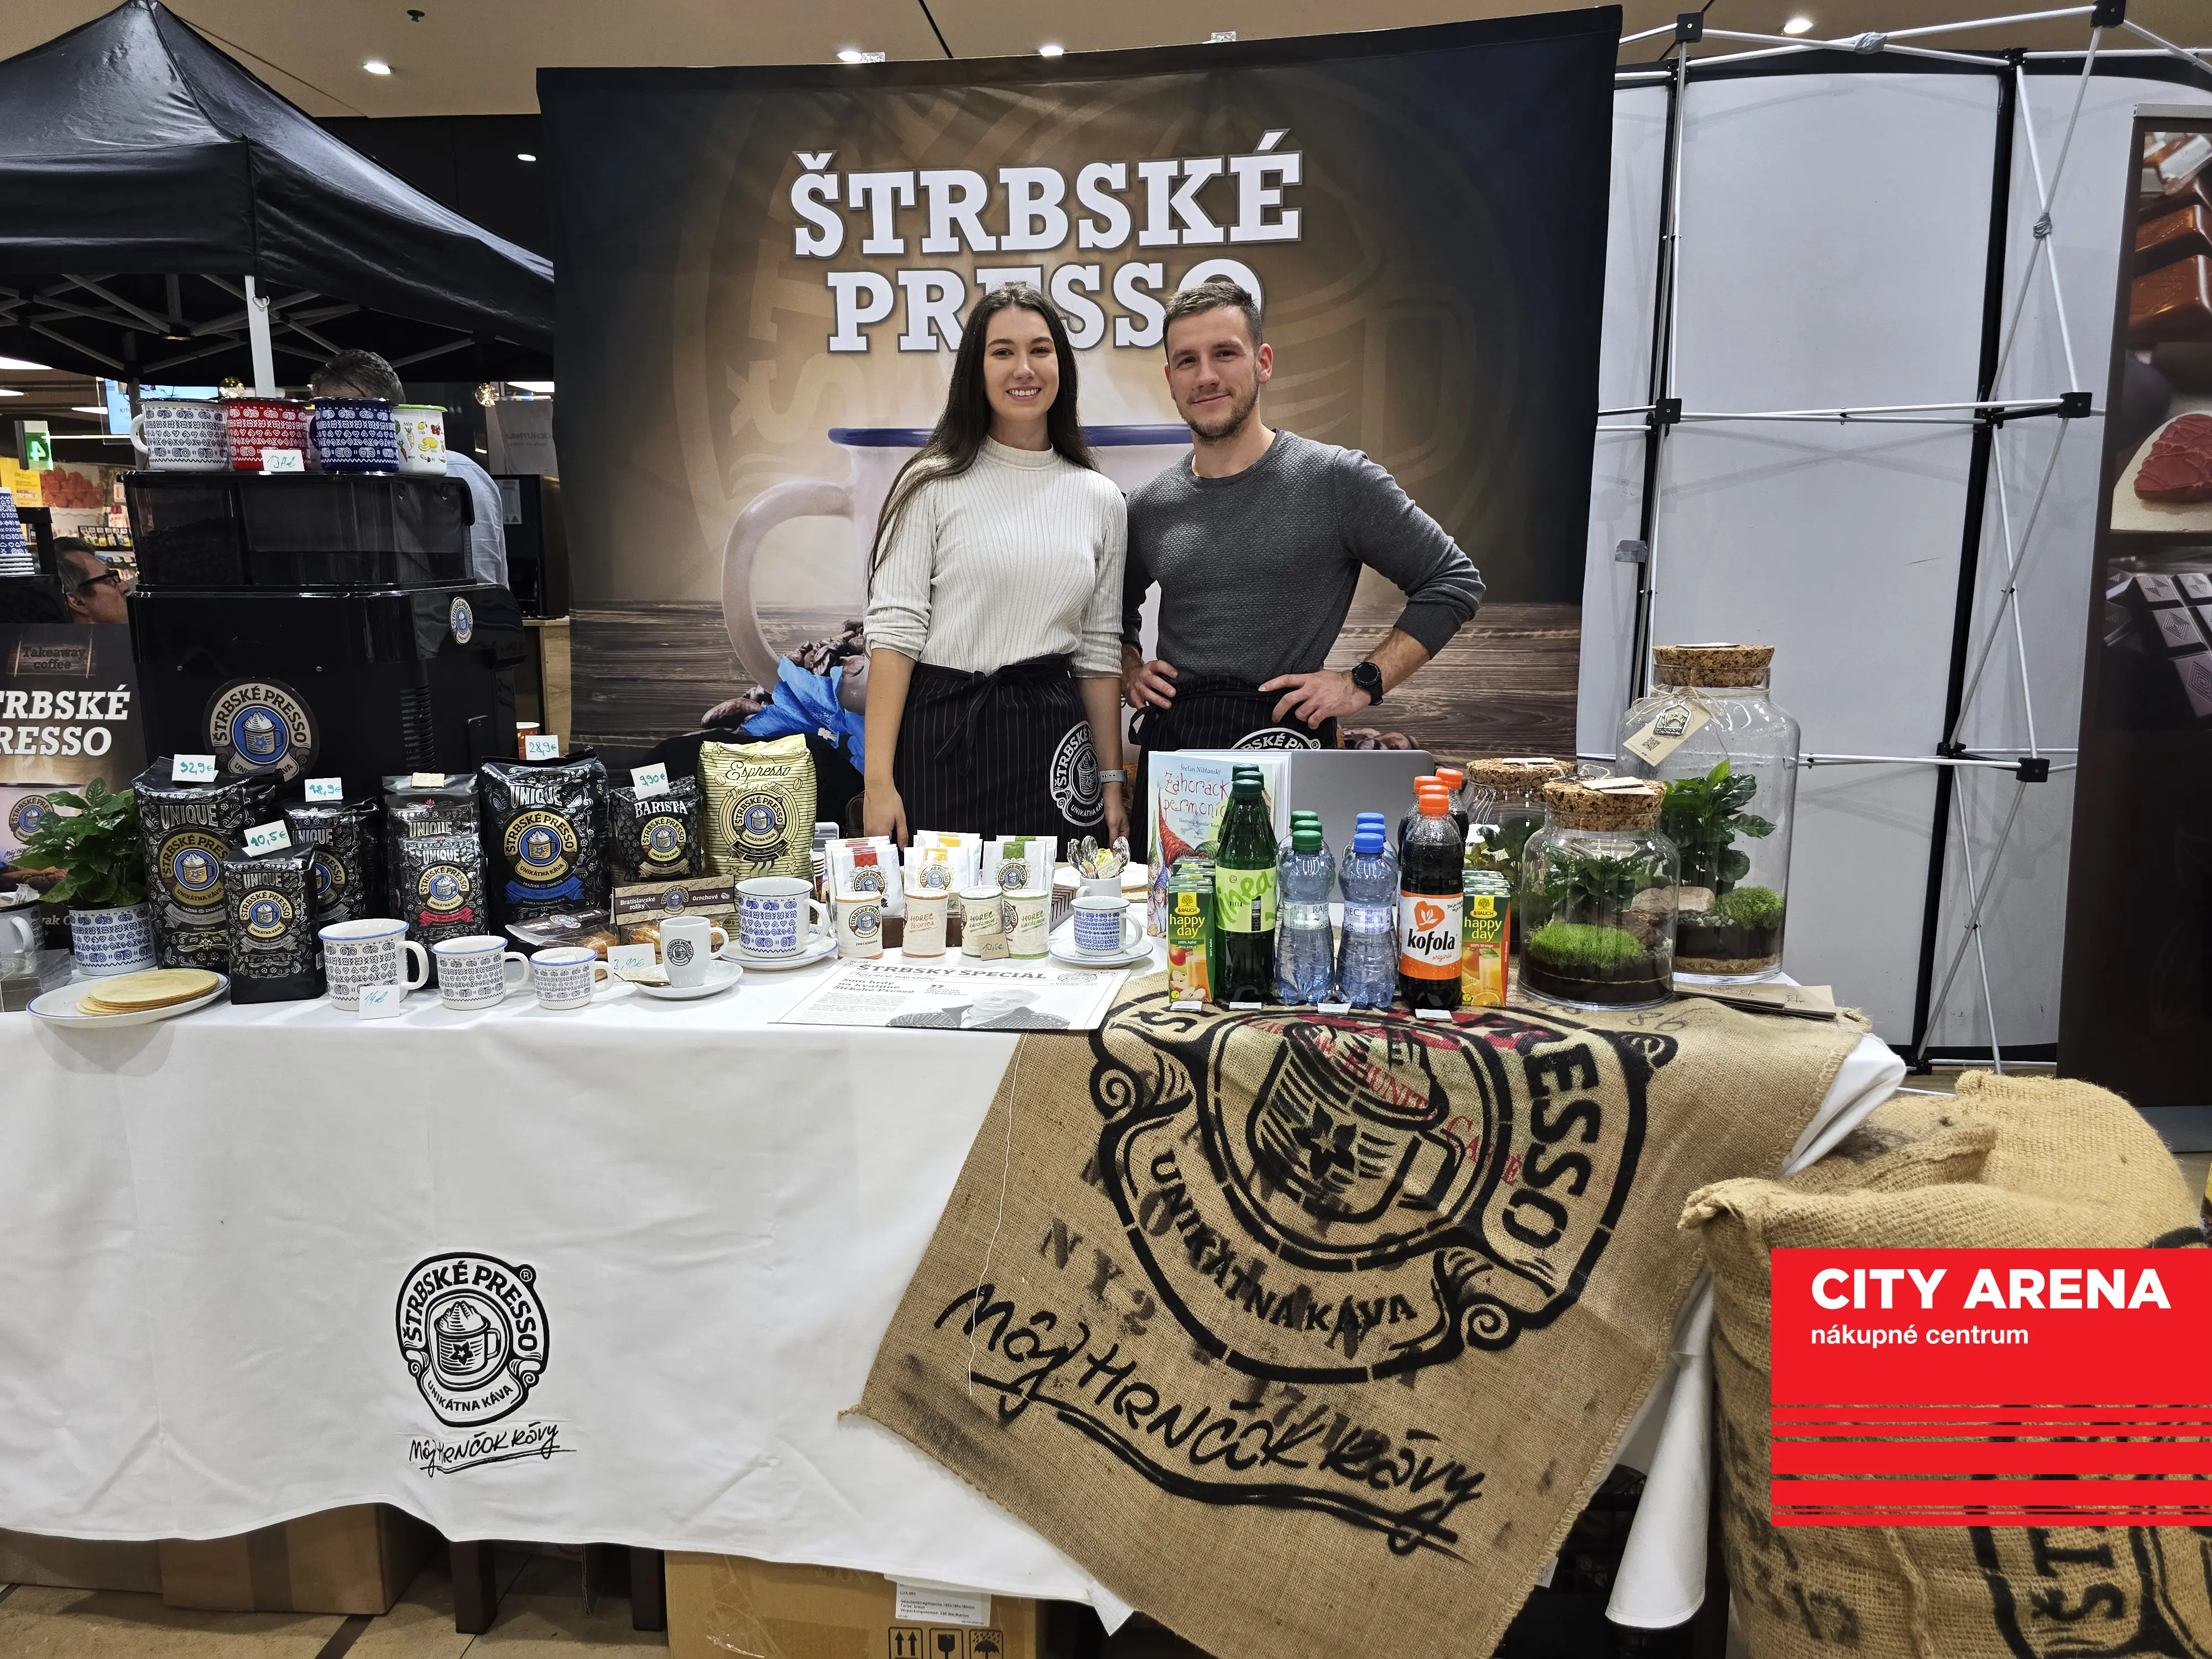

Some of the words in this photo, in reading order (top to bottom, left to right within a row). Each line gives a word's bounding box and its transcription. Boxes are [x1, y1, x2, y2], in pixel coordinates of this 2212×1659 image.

[791, 129, 1302, 257] ŠTRBSKÉ
[827, 258, 1264, 352] PRSS
[23, 646, 87, 661] Takeaway
[33, 659, 71, 669] coffee
[0, 684, 131, 720] RBSKÉ
[212, 685, 262, 742] ŠTRBSKÉ
[263, 689, 307, 743] PRESSO
[0, 726, 112, 756] RESSO
[1240, 733, 1286, 749] BSKÉ
[1055, 726, 1088, 787] ŠTRBSKÉ
[726, 761, 791, 782] Espresso
[1180, 764, 1196, 772] Štefan
[1196, 766, 1222, 776] Nižňanský
[1164, 770, 1230, 801] Záhoráck
[36, 798, 52, 813] PRES
[509, 786, 562, 808] UNIQUE
[1071, 804, 1095, 817] UNIKÁTNA
[1095, 799, 1104, 813] KÁV
[160, 804, 218, 830] UNIQUE
[634, 801, 688, 818] BARISTA
[735, 796, 761, 824] ŠTRBSKÉ
[763, 797, 784, 823] PRESSO
[1163, 799, 1227, 822] permoníc
[409, 821, 453, 838] UNIQUE
[505, 813, 541, 852] ŠTRBSKÉ
[542, 815, 575, 849] PRESSO
[643, 818, 665, 843] ŠTRBSKÉ
[665, 819, 685, 841] PRESSO
[163, 834, 196, 875] ŠTRBSKÉ
[198, 837, 228, 860] PRES
[423, 849, 460, 864] UNIQUE
[317, 854, 342, 882] PRESSO
[520, 865, 549, 877] UNIKÁTNA
[549, 864, 564, 875] KÁVA
[243, 873, 282, 889] UNIQUE
[420, 866, 445, 893] ŠTRBSKÉ
[446, 868, 467, 889] PRESSO
[177, 888, 206, 901] UNIKÁTNA
[241, 891, 268, 918] ŠTRBSKÉ
[268, 893, 290, 916] PRESSO
[620, 896, 656, 906] Bratislavské
[1217, 870, 1272, 929] inea
[1312, 903, 1328, 914] RAJE
[1344, 906, 1360, 916] AJEC
[1170, 914, 1206, 929] happy
[1177, 926, 1199, 939] day
[1464, 916, 1503, 931] happy
[1407, 928, 1455, 956] kofola
[1472, 930, 1495, 942] day
[857, 964, 957, 975] ŠTRBSKÝ
[958, 969, 1047, 979] ŠPECIÁL
[1152, 1149, 1295, 1327] UNIKÁTNA
[1307, 1294, 1417, 1333] KÁVA
[403, 1260, 468, 1342] ŠTRBSKÉ
[472, 1264, 538, 1351] PRESSO
[427, 1381, 480, 1412] UNIKÁTNA
[482, 1384, 514, 1408] KÁVA
